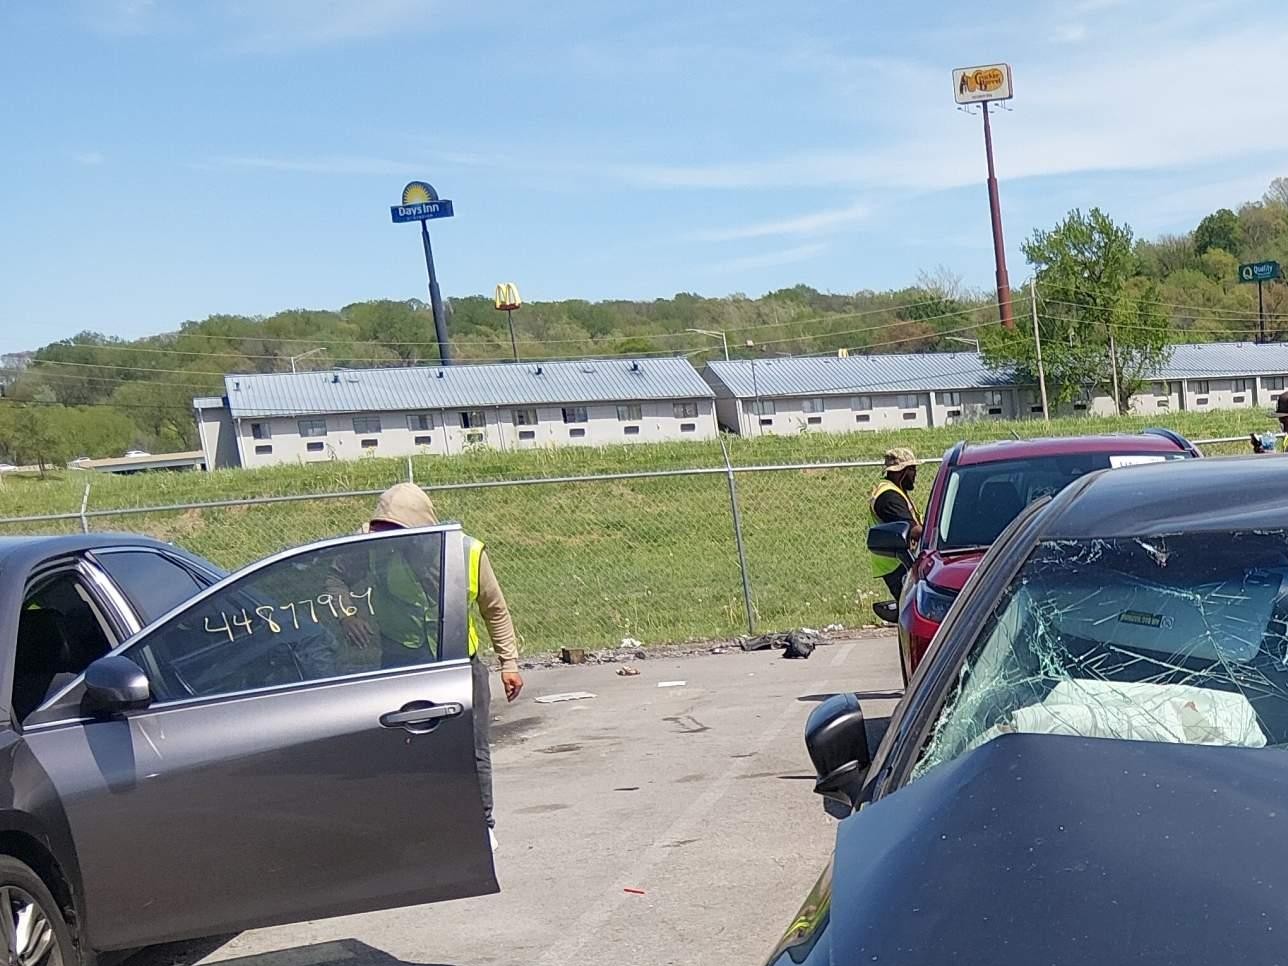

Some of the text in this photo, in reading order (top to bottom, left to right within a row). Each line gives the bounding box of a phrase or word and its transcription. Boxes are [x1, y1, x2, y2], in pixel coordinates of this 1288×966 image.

[399, 206, 422, 217] Days
[423, 203, 440, 213] Inn
[1253, 264, 1273, 274] Quality
